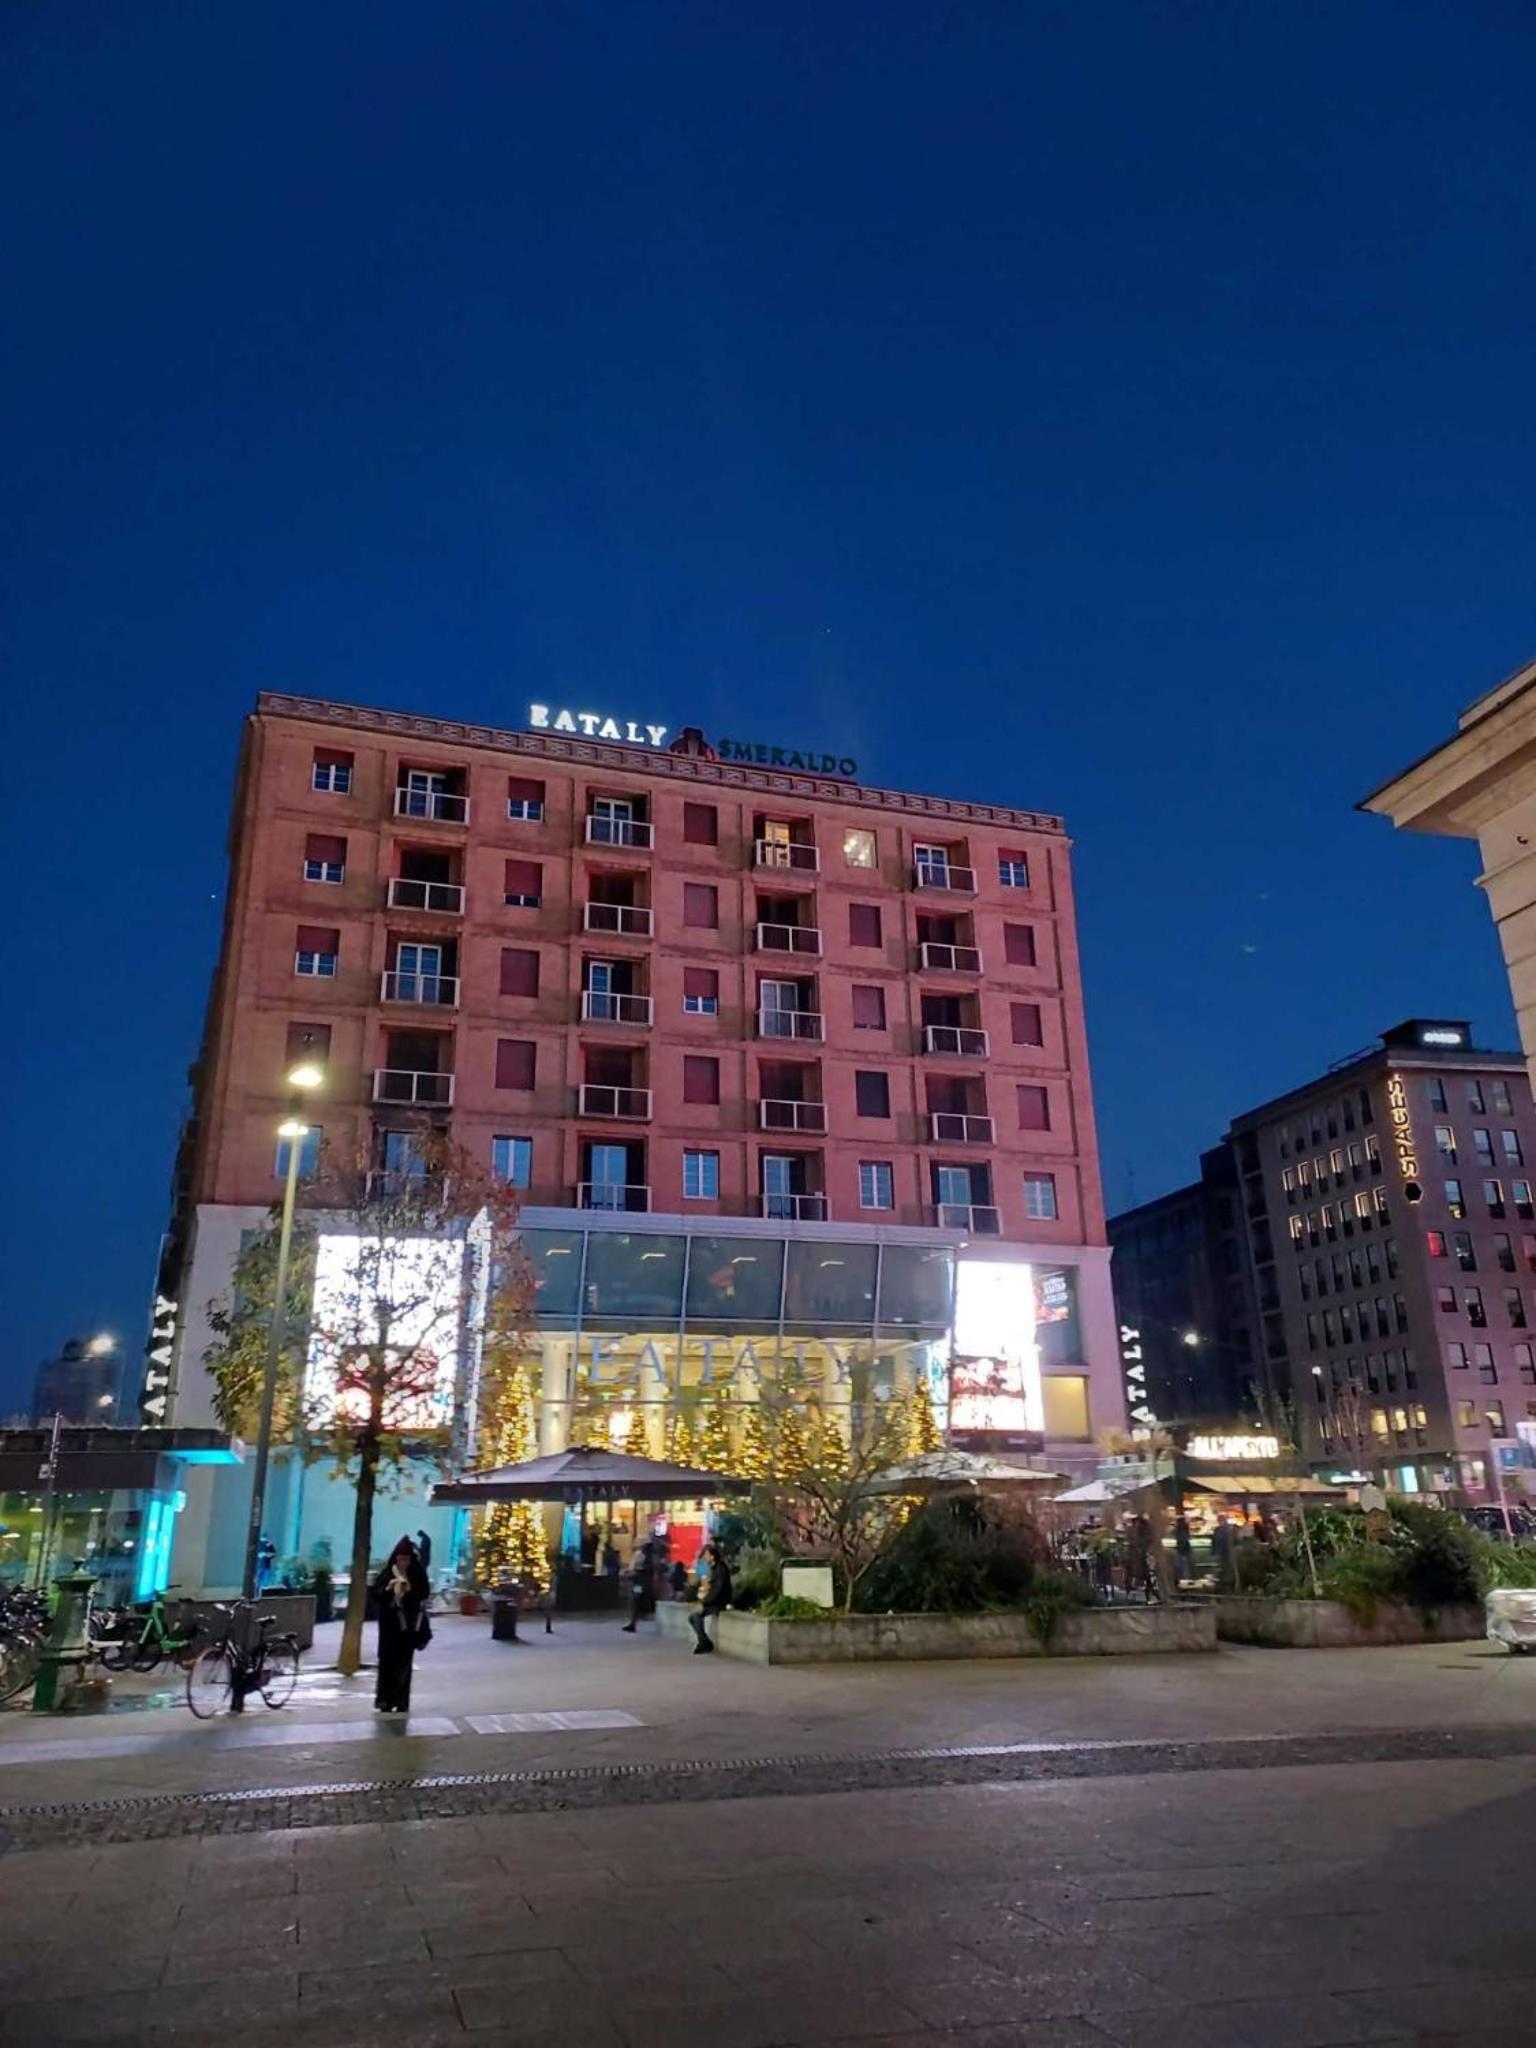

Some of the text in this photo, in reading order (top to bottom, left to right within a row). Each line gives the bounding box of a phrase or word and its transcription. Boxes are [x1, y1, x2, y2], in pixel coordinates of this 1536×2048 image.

[530, 704, 667, 747] EATALY
[717, 738, 857, 777] SMERALDO
[1388, 1073, 1418, 1179] SPACES
[141, 1294, 178, 1430] ATALY
[587, 1336, 858, 1385] EATALY
